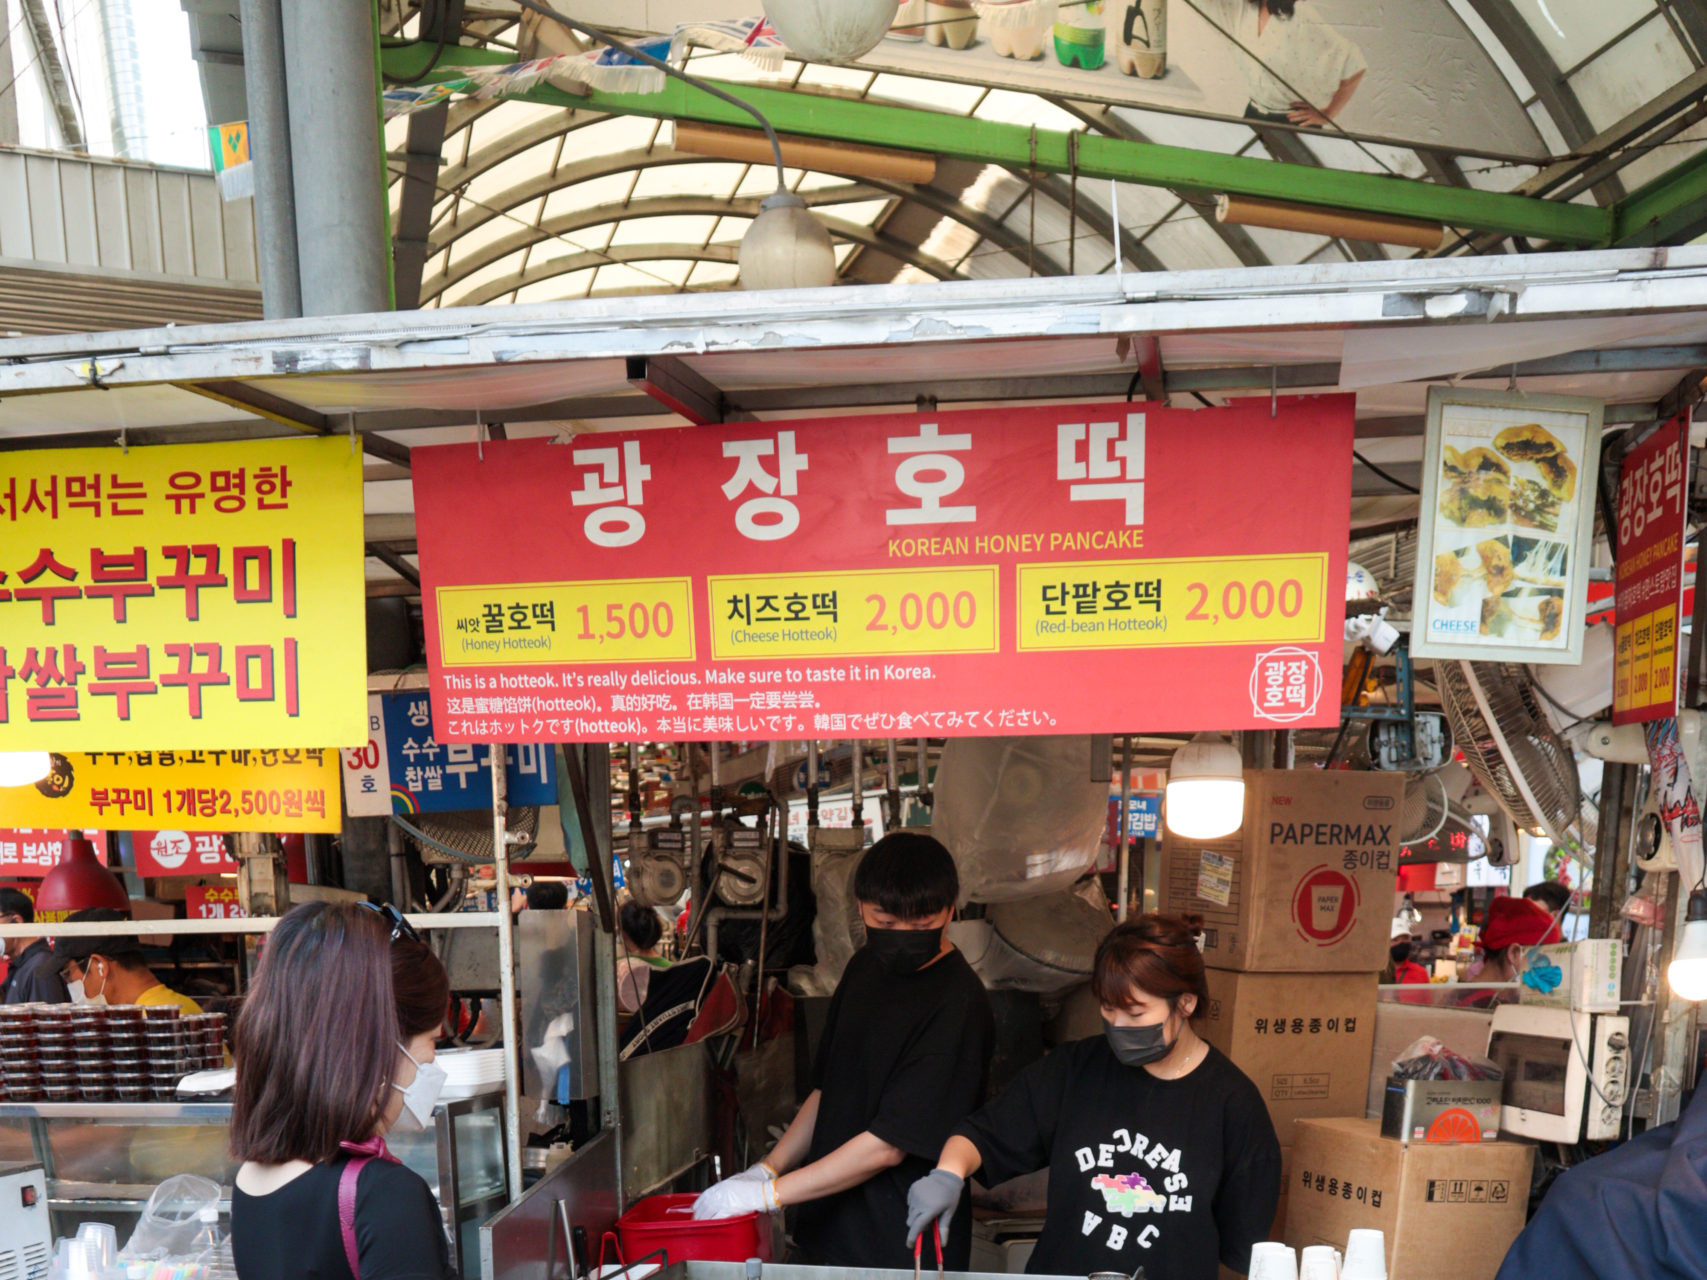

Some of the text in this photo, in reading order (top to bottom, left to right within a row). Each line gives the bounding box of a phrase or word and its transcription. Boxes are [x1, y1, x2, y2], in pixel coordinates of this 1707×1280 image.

[165, 465, 293, 515] 유명한
[888, 530, 1144, 559] KOREAN HONEY PANCAKE
[0, 538, 298, 625] 수부꾸미
[727, 591, 977, 636] 치즈호떡 2,000
[1041, 578, 1303, 625] 단팥호떡 2,000
[576, 600, 674, 645] 1,500
[1035, 615, 1168, 637] (Red-bean Hotteok)
[1432, 618, 1477, 632] CHEESE
[461, 634, 552, 653] (Honey Hotteok)
[730, 626, 838, 646] (Cheese Hotteok)
[0, 637, 298, 722] 쌀부꾸미
[443, 674, 472, 690] This
[475, 674, 485, 689] is
[489, 677, 497, 689] a
[500, 672, 559, 689] hotteok.
[587, 670, 628, 690] really
[631, 668, 702, 687] delicious.
[705, 668, 745, 684] Make
[749, 669, 782, 683] sure
[785, 668, 803, 682] to
[806, 667, 846, 682] taste
[849, 666, 861, 681] it
[865, 665, 879, 680] in
[884, 665, 936, 680] Korea.
[1264, 660, 1308, 687] 광장
[1263, 684, 1307, 709] 호떡
[347, 740, 380, 770] 30
[402, 736, 441, 762] 수수
[361, 775, 378, 793] 호
[404, 766, 443, 792] 찹쌀
[90, 787, 154, 817] 부꾸미
[1269, 822, 1392, 846] PAPERMAX
[1342, 849, 1391, 871] 종이컵
[1319, 904, 1335, 912] MAX
